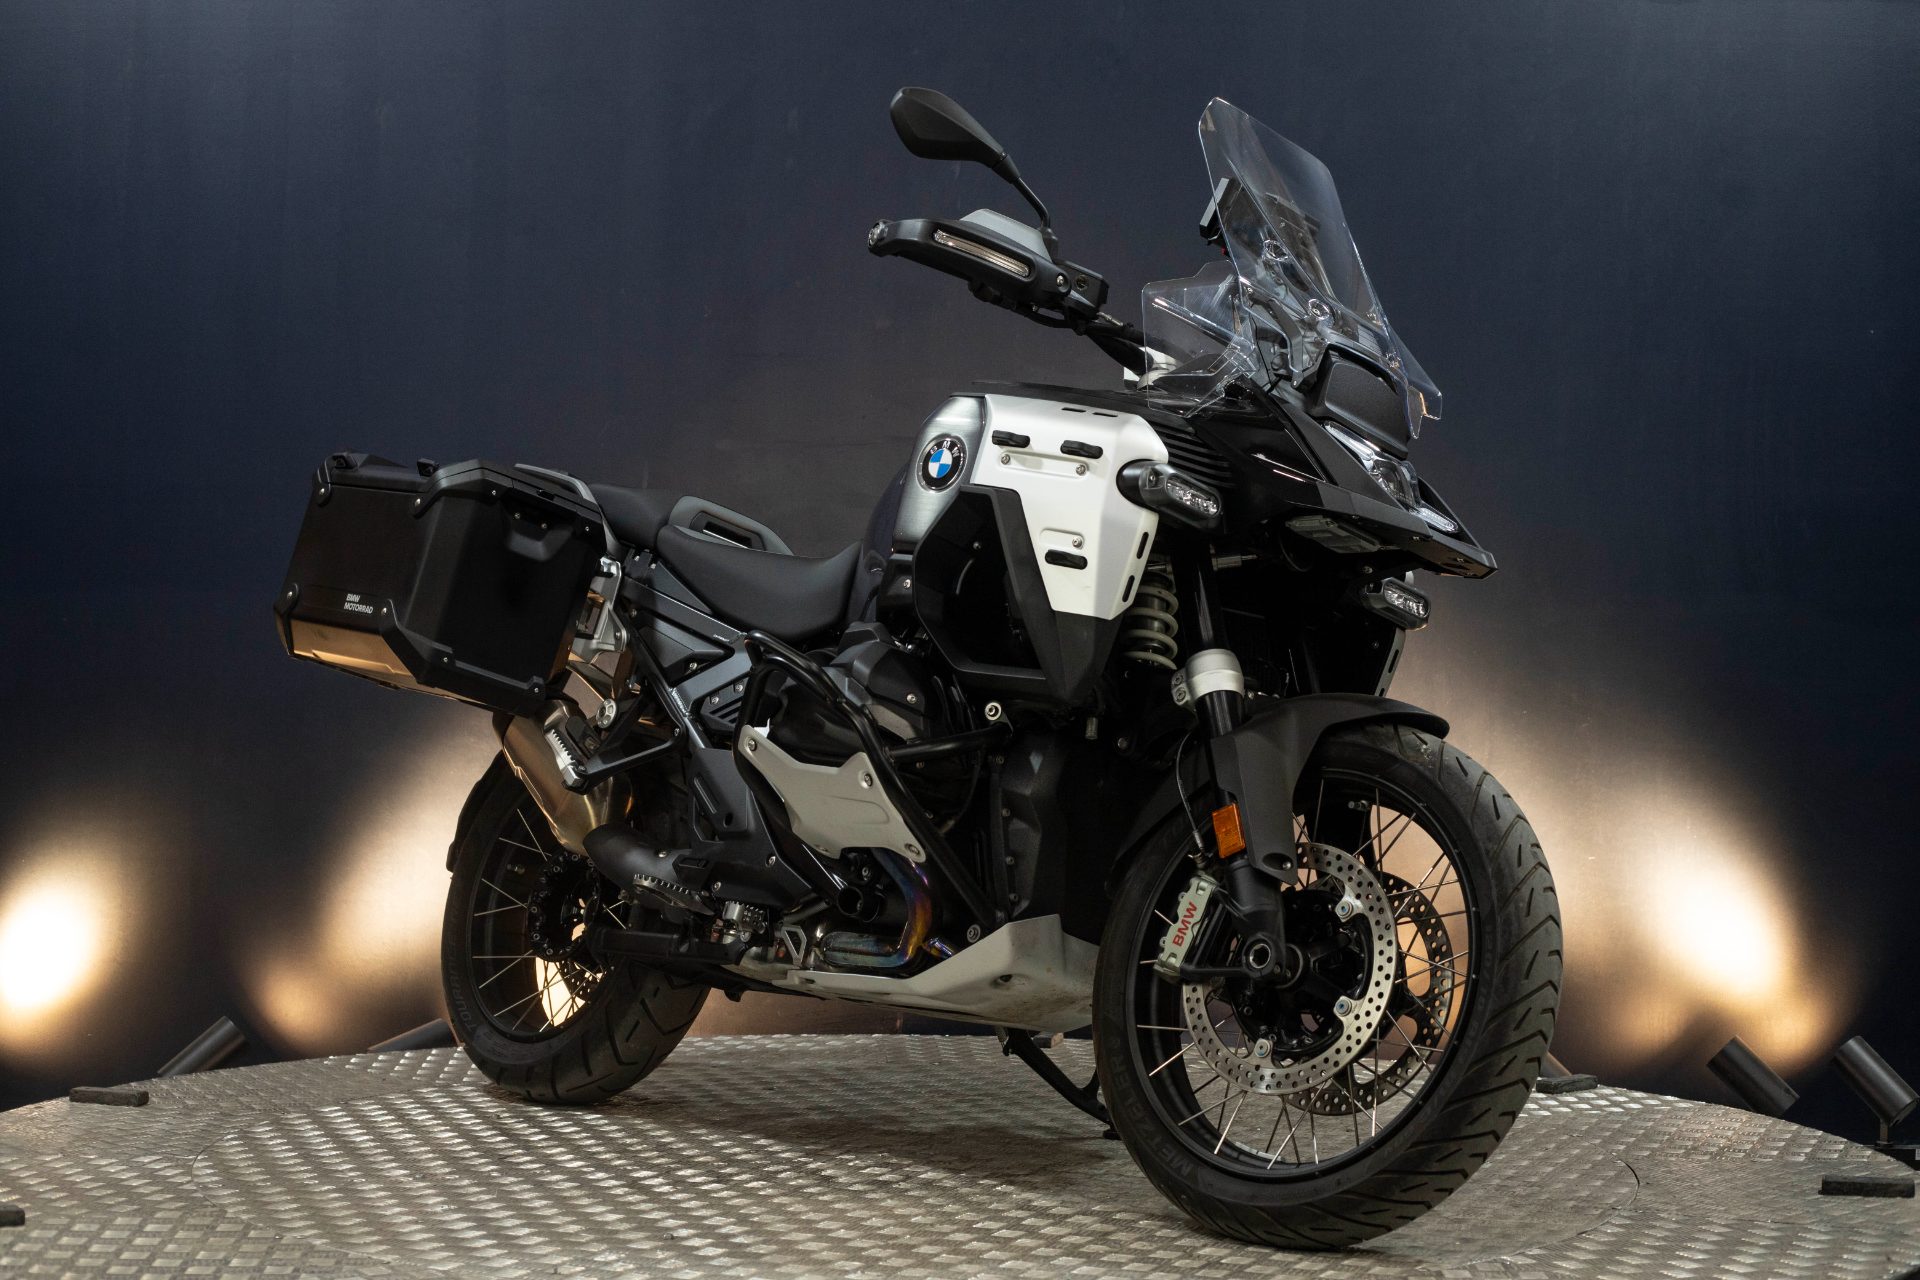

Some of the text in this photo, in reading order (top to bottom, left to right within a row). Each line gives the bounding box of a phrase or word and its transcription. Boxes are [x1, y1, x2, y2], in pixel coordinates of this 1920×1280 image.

[930, 440, 960, 458] BMW
[346, 593, 361, 603] BMW
[344, 602, 374, 614] MOTORRAD
[1172, 901, 1197, 947] BMW
